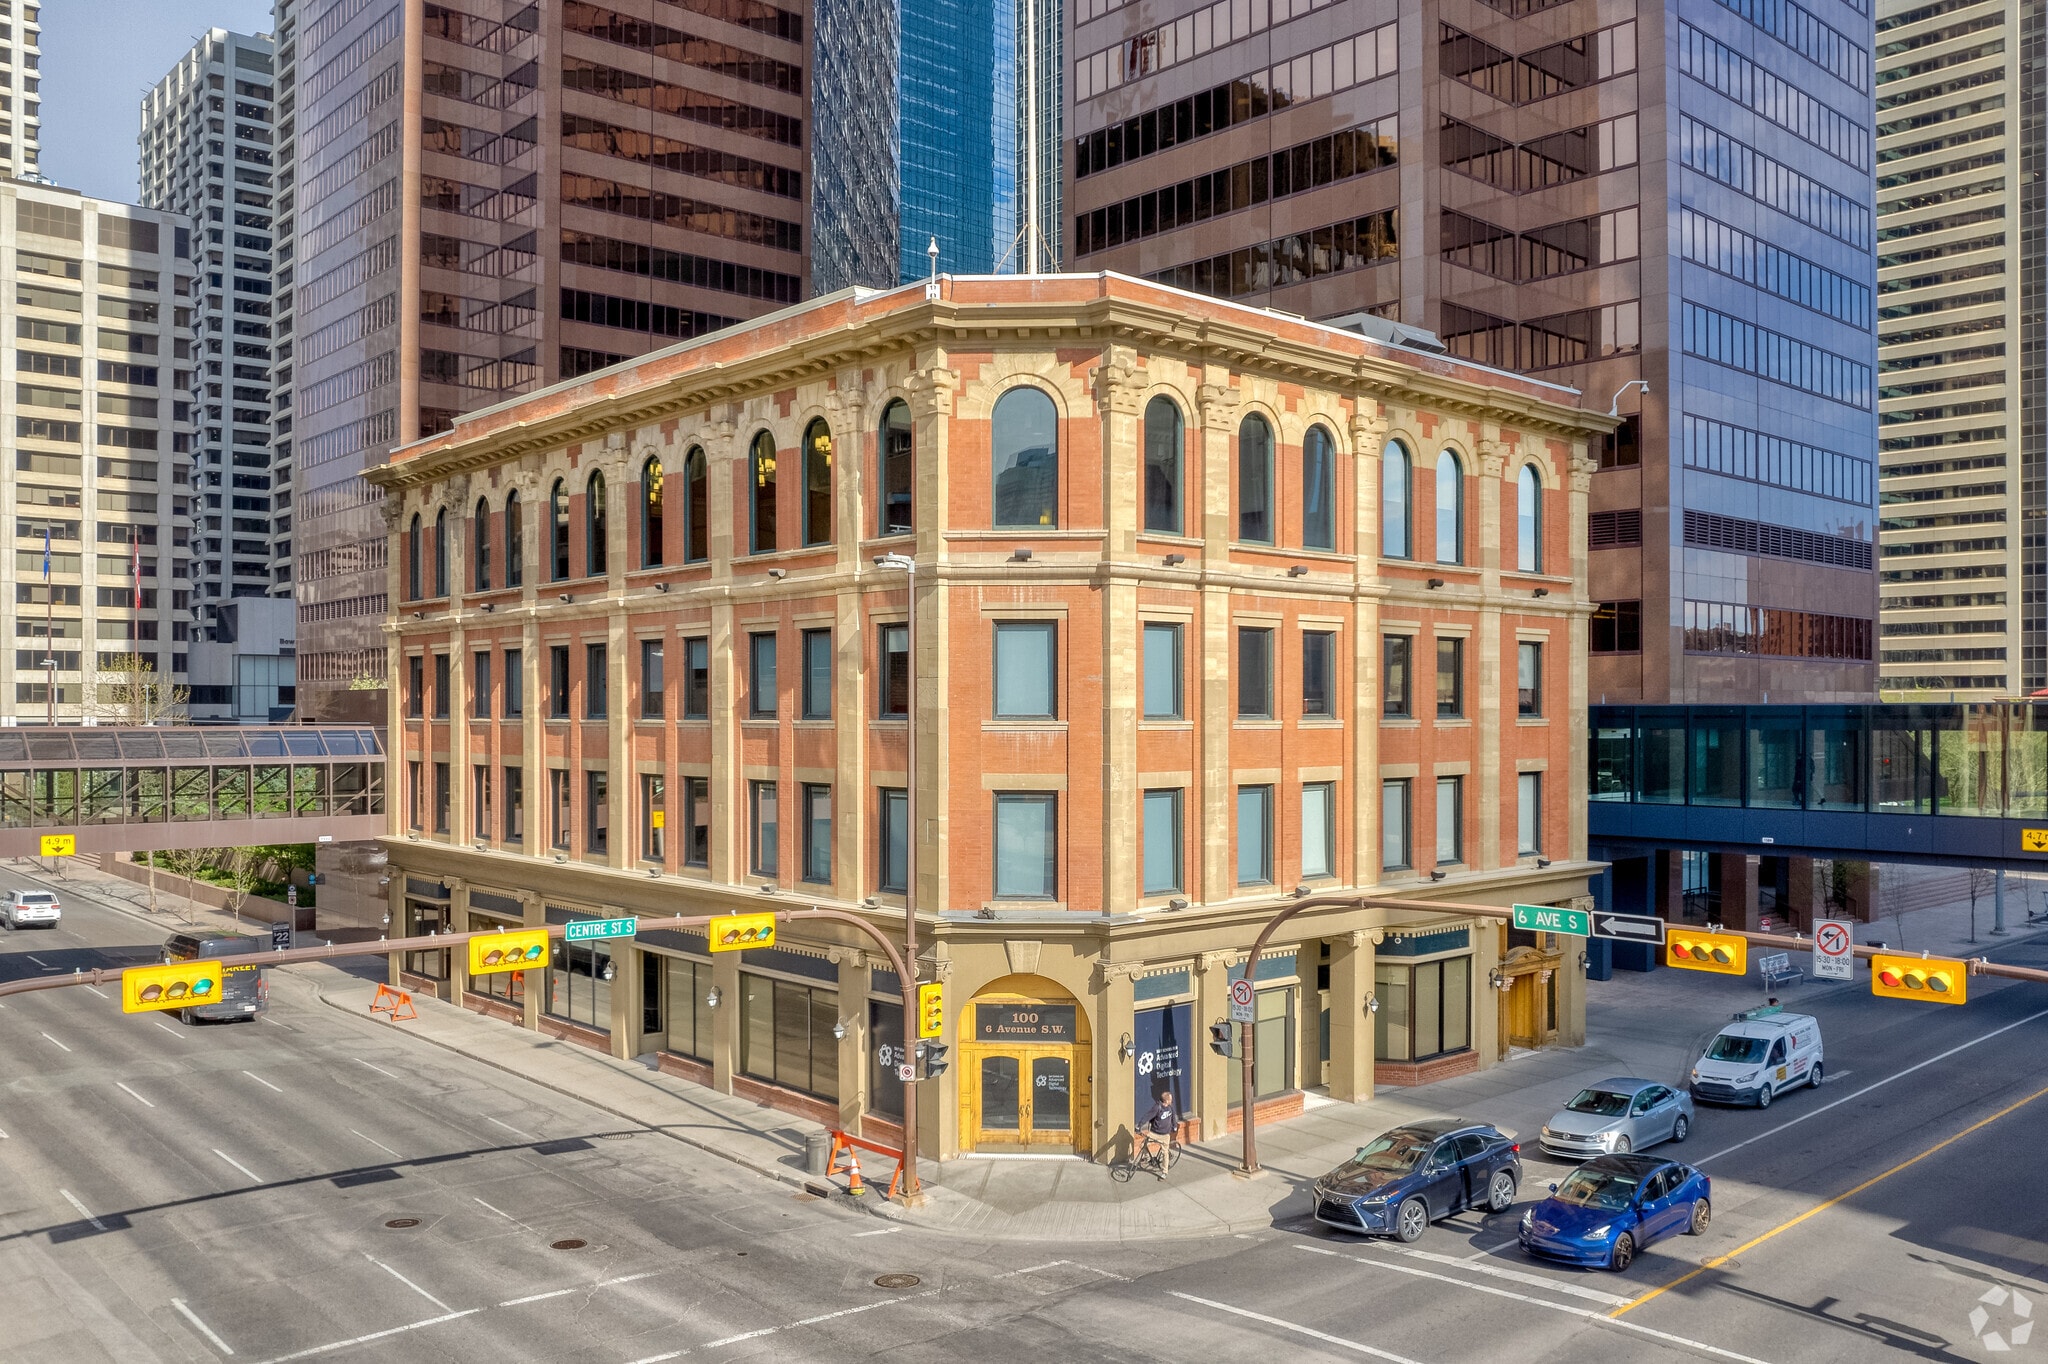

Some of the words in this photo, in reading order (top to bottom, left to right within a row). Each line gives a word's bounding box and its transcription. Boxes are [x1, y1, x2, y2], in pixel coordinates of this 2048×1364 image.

[45, 837, 60, 845] 4.9
[2027, 832, 2042, 840] 4.7
[1518, 910, 1528, 924] 6
[1535, 911, 1562, 928] AVE
[1568, 914, 1578, 930] S
[569, 923, 607, 938] CENTRE
[611, 921, 623, 935] ST
[626, 920, 633, 933] S
[1012, 1013, 1039, 1024] 100
[985, 1025, 992, 1033] 6
[996, 1025, 1037, 1034] Avenue
[1041, 1025, 1067, 1034] S.W.
